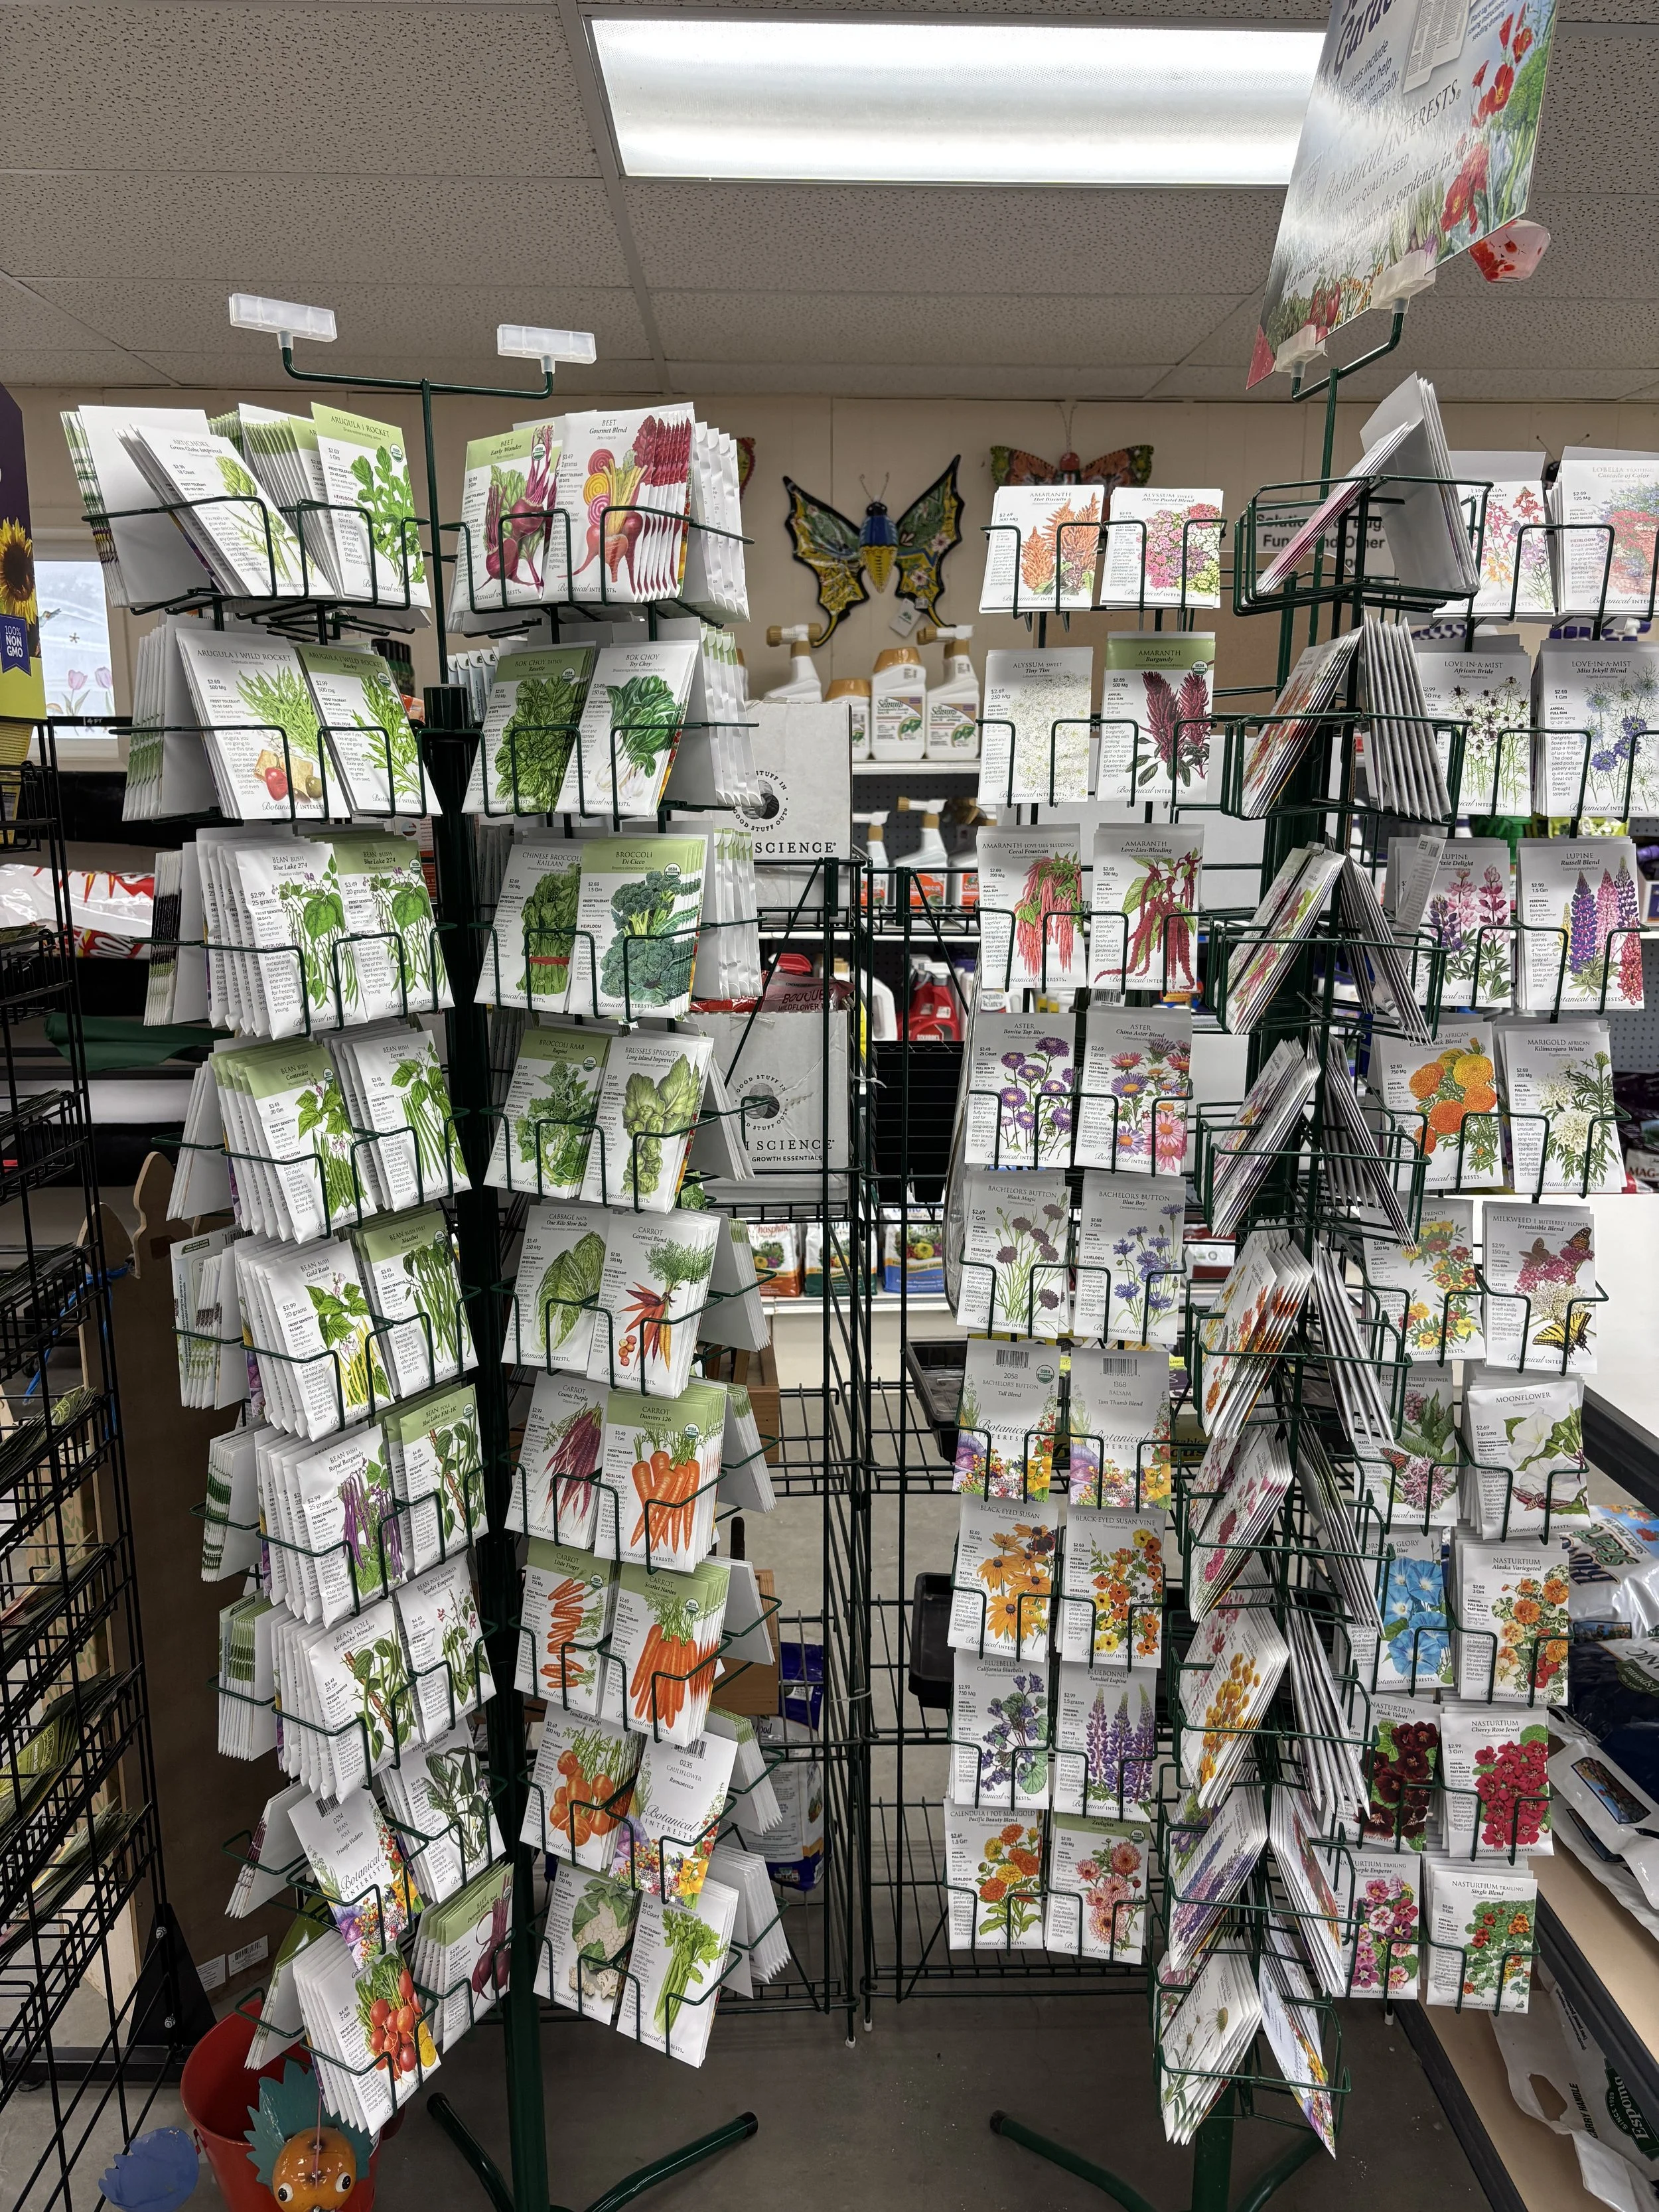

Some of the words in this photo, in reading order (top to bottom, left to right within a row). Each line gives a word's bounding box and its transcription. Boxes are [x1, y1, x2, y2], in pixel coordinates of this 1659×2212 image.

[1377, 57, 1392, 78] help
[1392, 153, 1409, 175] SEED
[1394, 162, 1439, 210] gardener
[331, 415, 361, 429] ARUGULA
[366, 425, 390, 437] ROCKET
[500, 438, 514, 447] BEET
[505, 443, 522, 453] Wonder
[5, 625, 21, 636] 100%
[5, 635, 22, 646] NON
[7, 646, 23, 658] GMO
[733, 810, 749, 828] GOOD
[625, 1047, 651, 1056] BRUSSELS
[736, 1076, 754, 1094] GOOD
[757, 1074, 780, 1084] STUFF
[638, 1226, 664, 1236] CARROT
[300, 1262, 316, 1272] BEAN
[316, 1258, 330, 1267] BUSH
[306, 1268, 319, 1278] Gold
[282, 1302, 297, 1311] $2.99
[1496, 1392, 1551, 1403] MOONFLOWER
[642, 1406, 670, 1415] CARROT
[328, 1460, 342, 1472] Royal
[342, 1451, 364, 1467] Burgundy
[330, 1453, 345, 1463] BEAN
[346, 1447, 358, 1457] BUSH
[1019, 1511, 1040, 1519] SUSAN
[333, 1634, 355, 1651] Kentucky
[356, 1623, 375, 1639] Wonder
[336, 1629, 352, 1642] BEAN
[353, 1619, 370, 1631] POLE
[680, 1759, 693, 1768] 0235
[666, 1765, 702, 1782] CAULIFLOWER
[669, 1777, 694, 1790] Romanesco
[333, 1813, 344, 1824] 0214
[643, 1805, 699, 1832] Botanical
[341, 1848, 382, 1893] Botanical
[1569, 2083, 1588, 2112] HANDLE
